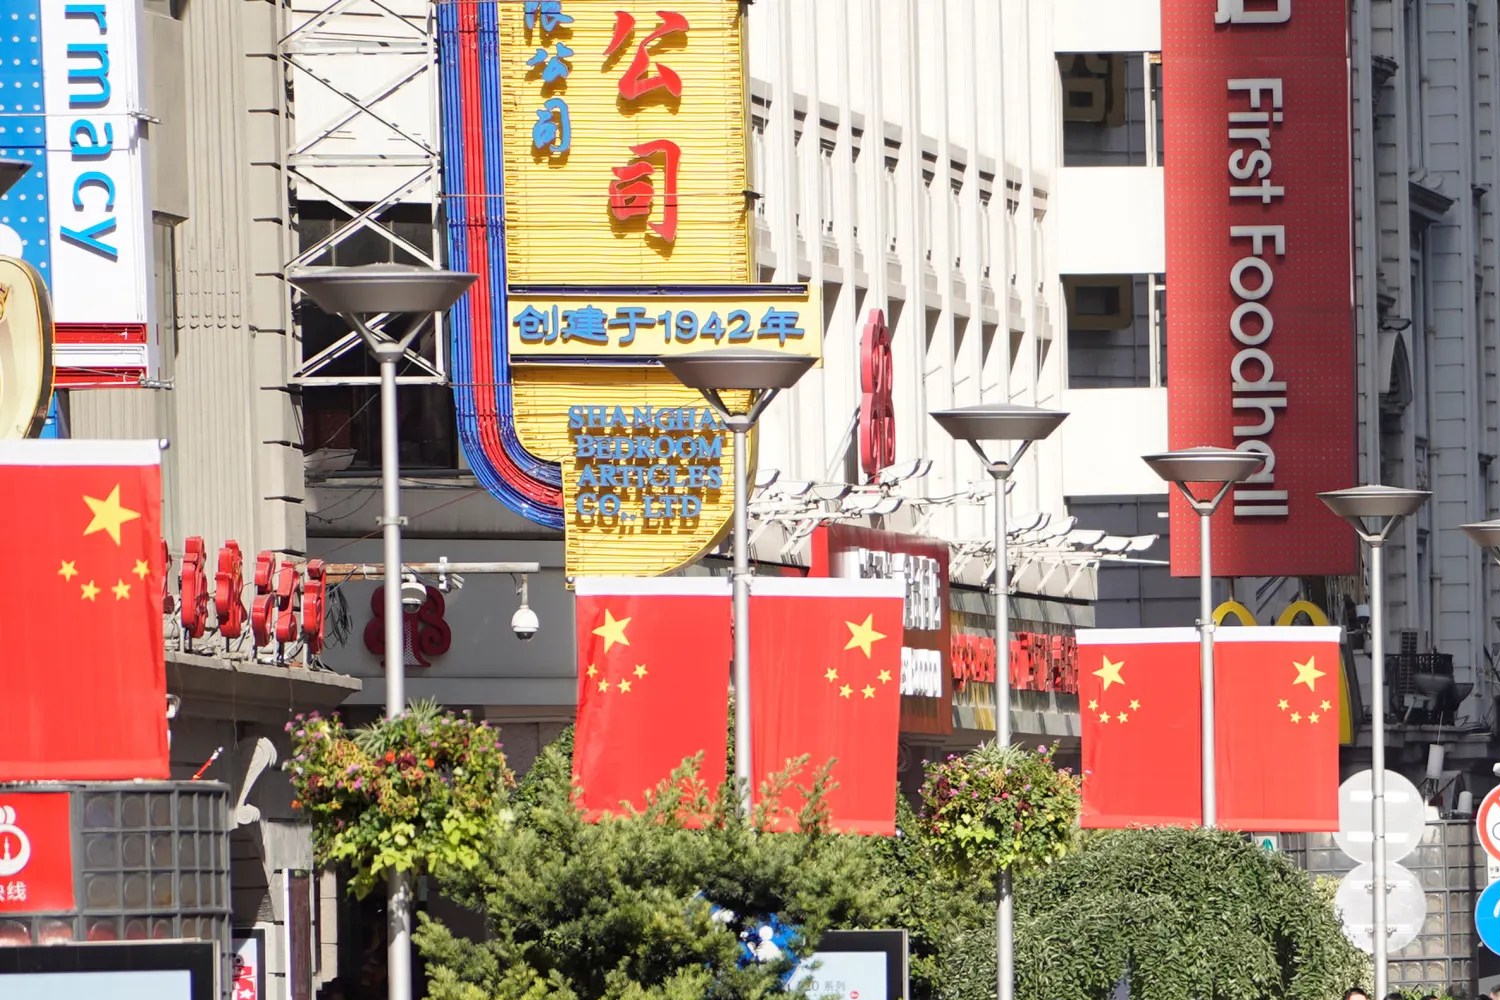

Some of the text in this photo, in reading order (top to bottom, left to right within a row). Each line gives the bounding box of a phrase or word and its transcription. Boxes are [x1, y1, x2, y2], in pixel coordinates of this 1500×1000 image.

[59, 4, 119, 260] rmacy
[602, 10, 689, 243] 公司
[1227, 77, 1285, 204] First
[512, 304, 805, 348] 创建于1942年
[1229, 224, 1289, 517] Foodhall
[575, 434, 723, 459] BEDROOM
[576, 463, 723, 489] ARTICLES
